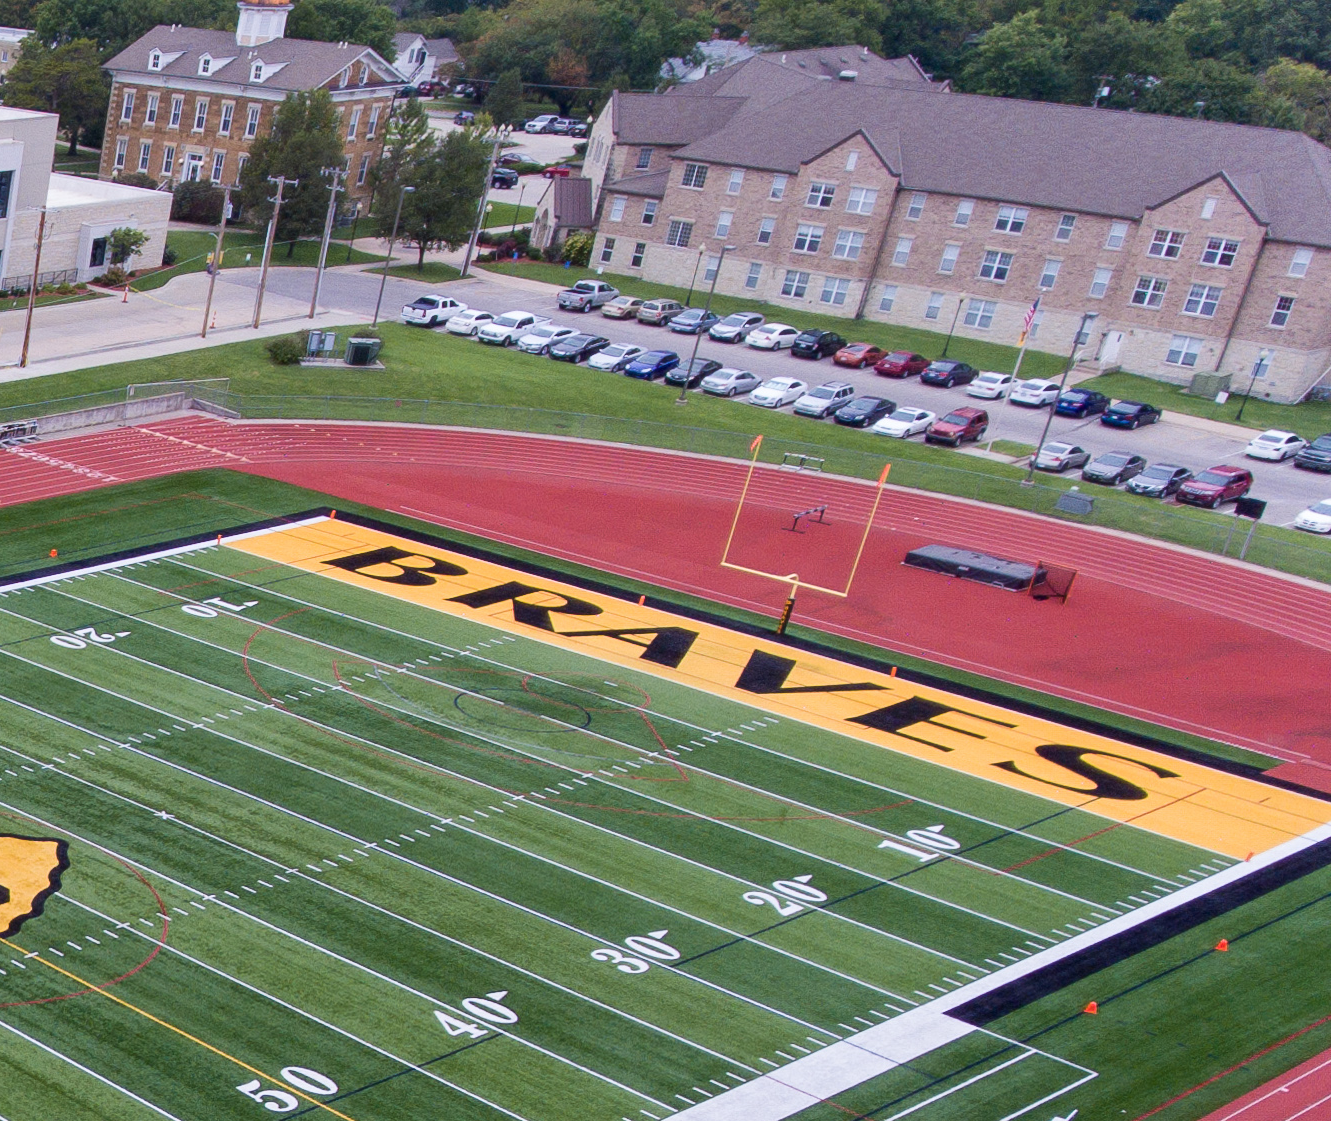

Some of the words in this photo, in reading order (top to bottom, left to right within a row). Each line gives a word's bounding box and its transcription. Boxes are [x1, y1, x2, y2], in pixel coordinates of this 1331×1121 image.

[180, 597, 245, 617] 10
[50, 627, 116, 650] 20
[322, 546, 1181, 801] BRAVES
[877, 827, 961, 862] 10
[743, 880, 828, 916] 20
[592, 934, 681, 973] 30
[433, 996, 518, 1039] 40
[235, 1065, 338, 1112] 50
